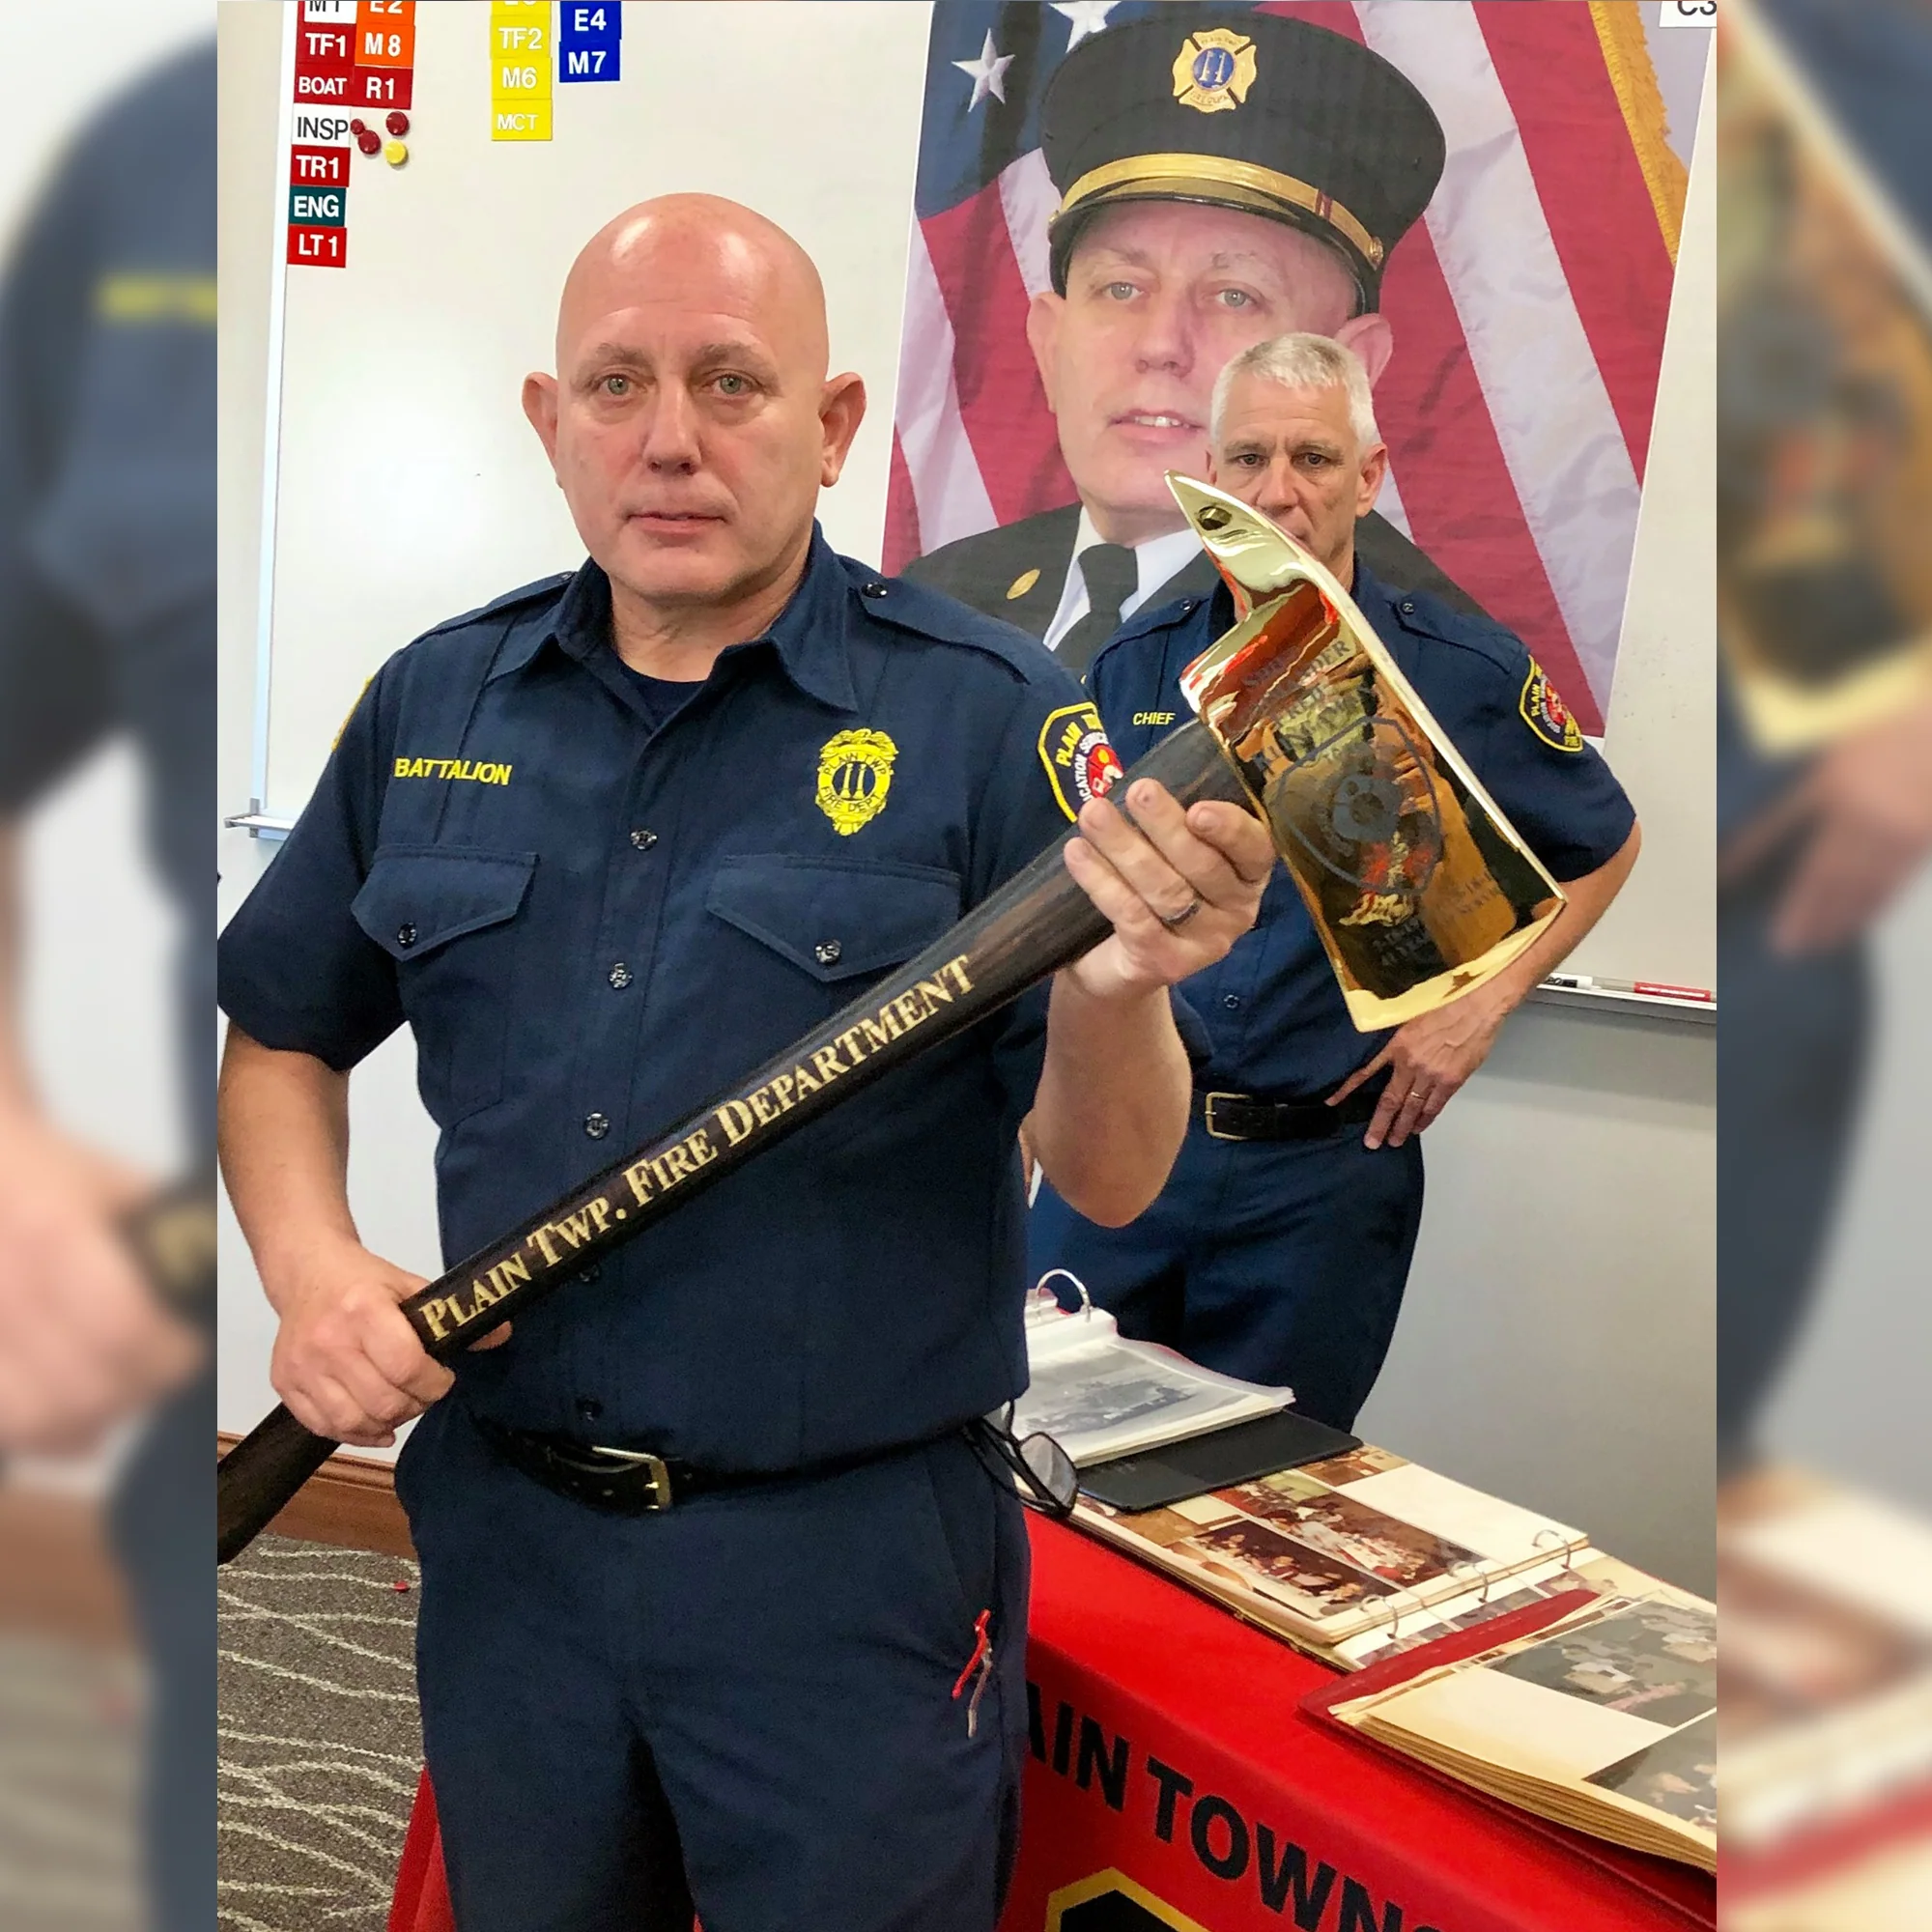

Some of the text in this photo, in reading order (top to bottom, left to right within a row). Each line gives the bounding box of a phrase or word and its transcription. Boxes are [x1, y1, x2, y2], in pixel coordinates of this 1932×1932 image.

[575, 9, 607, 31] E4
[305, 32, 346, 57] TF1
[365, 32, 401, 57] M8
[498, 27, 542, 49] TF2
[568, 51, 607, 73] M7
[298, 76, 347, 95] BOAT
[366, 76, 394, 99] R1
[502, 67, 537, 89] M6
[297, 117, 349, 140] INSP
[497, 113, 538, 131] MCT
[296, 155, 339, 179] TR1
[294, 195, 339, 217] ENG
[1133, 712, 1176, 725] CHIEF
[393, 758, 513, 785] BATTALION
[824, 753, 858, 776] PLAIN
[821, 785, 843, 810] FIRE
[418, 954, 977, 1342] PLAIN TWP. FIRE DEPARTMENT
[1147, 1755, 1445, 1932] TOWN
